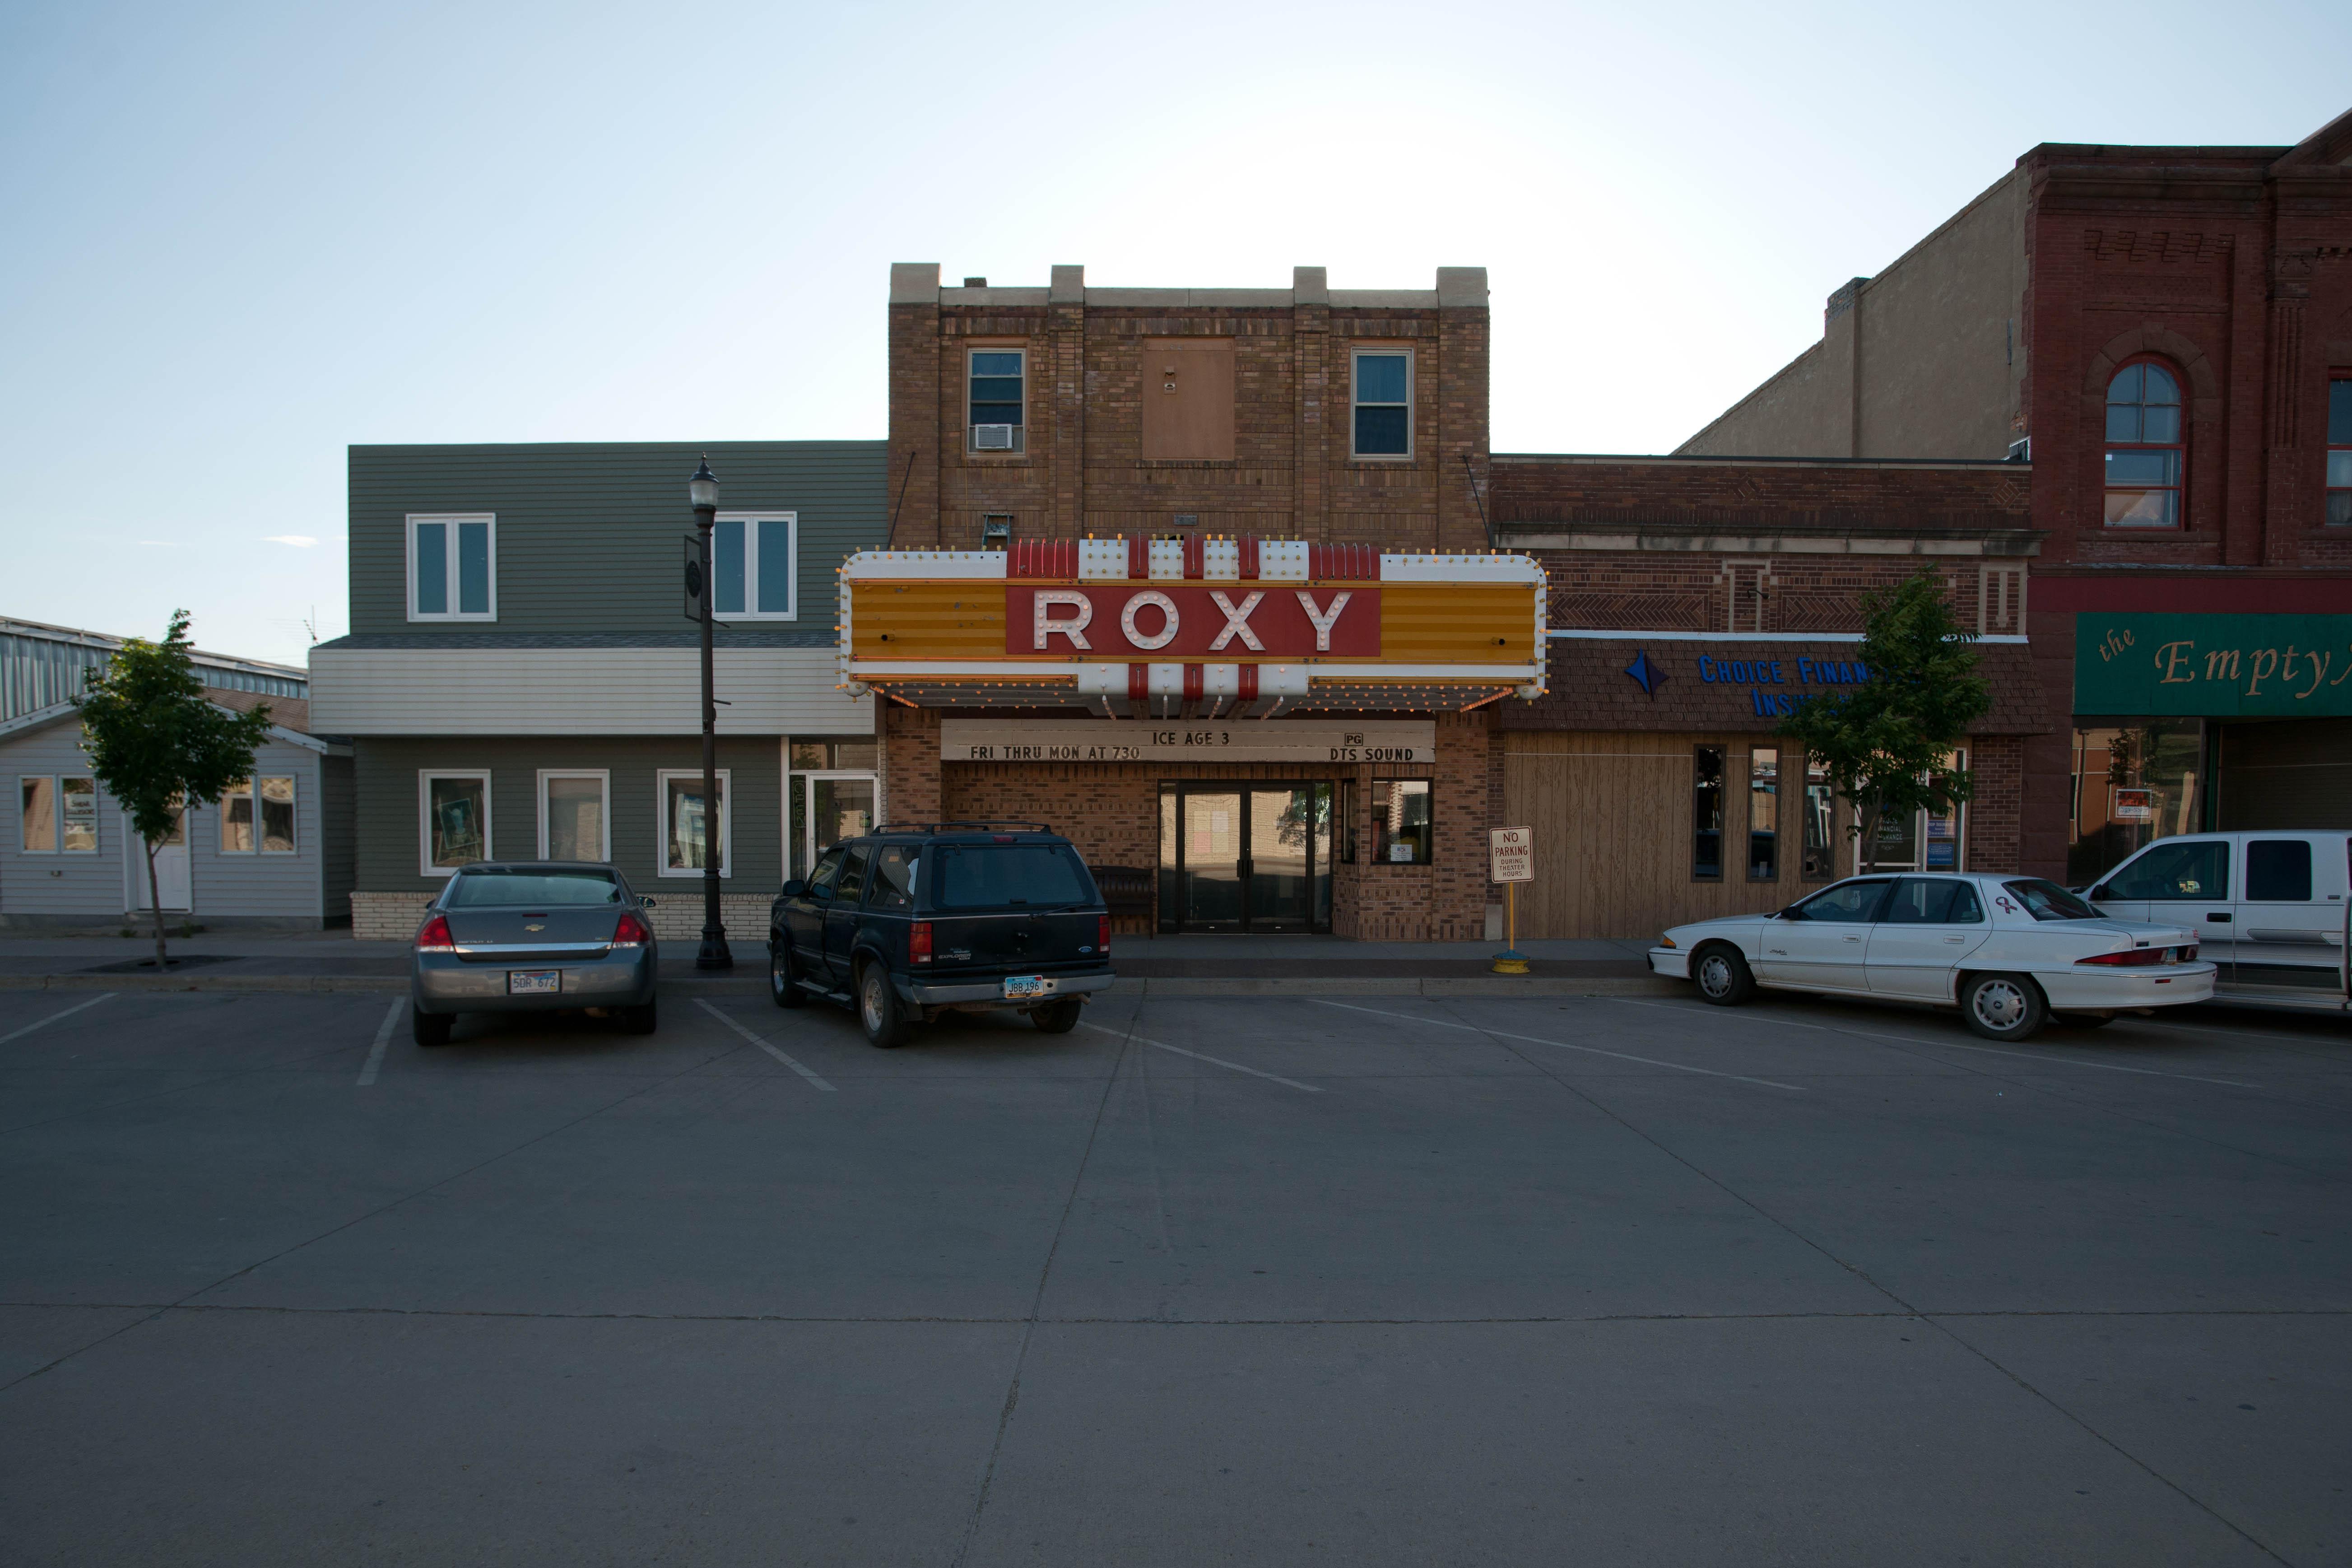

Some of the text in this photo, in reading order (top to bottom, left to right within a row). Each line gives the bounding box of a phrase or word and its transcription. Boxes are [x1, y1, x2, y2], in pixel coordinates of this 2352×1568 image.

[1034, 590, 1353, 651] ROXY
[2098, 628, 2135, 662] the
[1698, 654, 1921, 686] CHOICE FINAN
[2154, 640, 2331, 699] Empty
[1153, 732, 1229, 744] ICE AGE 3
[1346, 735, 1362, 744] PG
[971, 746, 1140, 759] FRI THRU MON AT 730
[1330, 748, 1413, 761] DTS SOUND
[1503, 833, 1519, 843] NO
[1495, 845, 1528, 856] PARKING
[538, 977, 555, 987] 672
[1009, 982, 1039, 992] JBB 196
